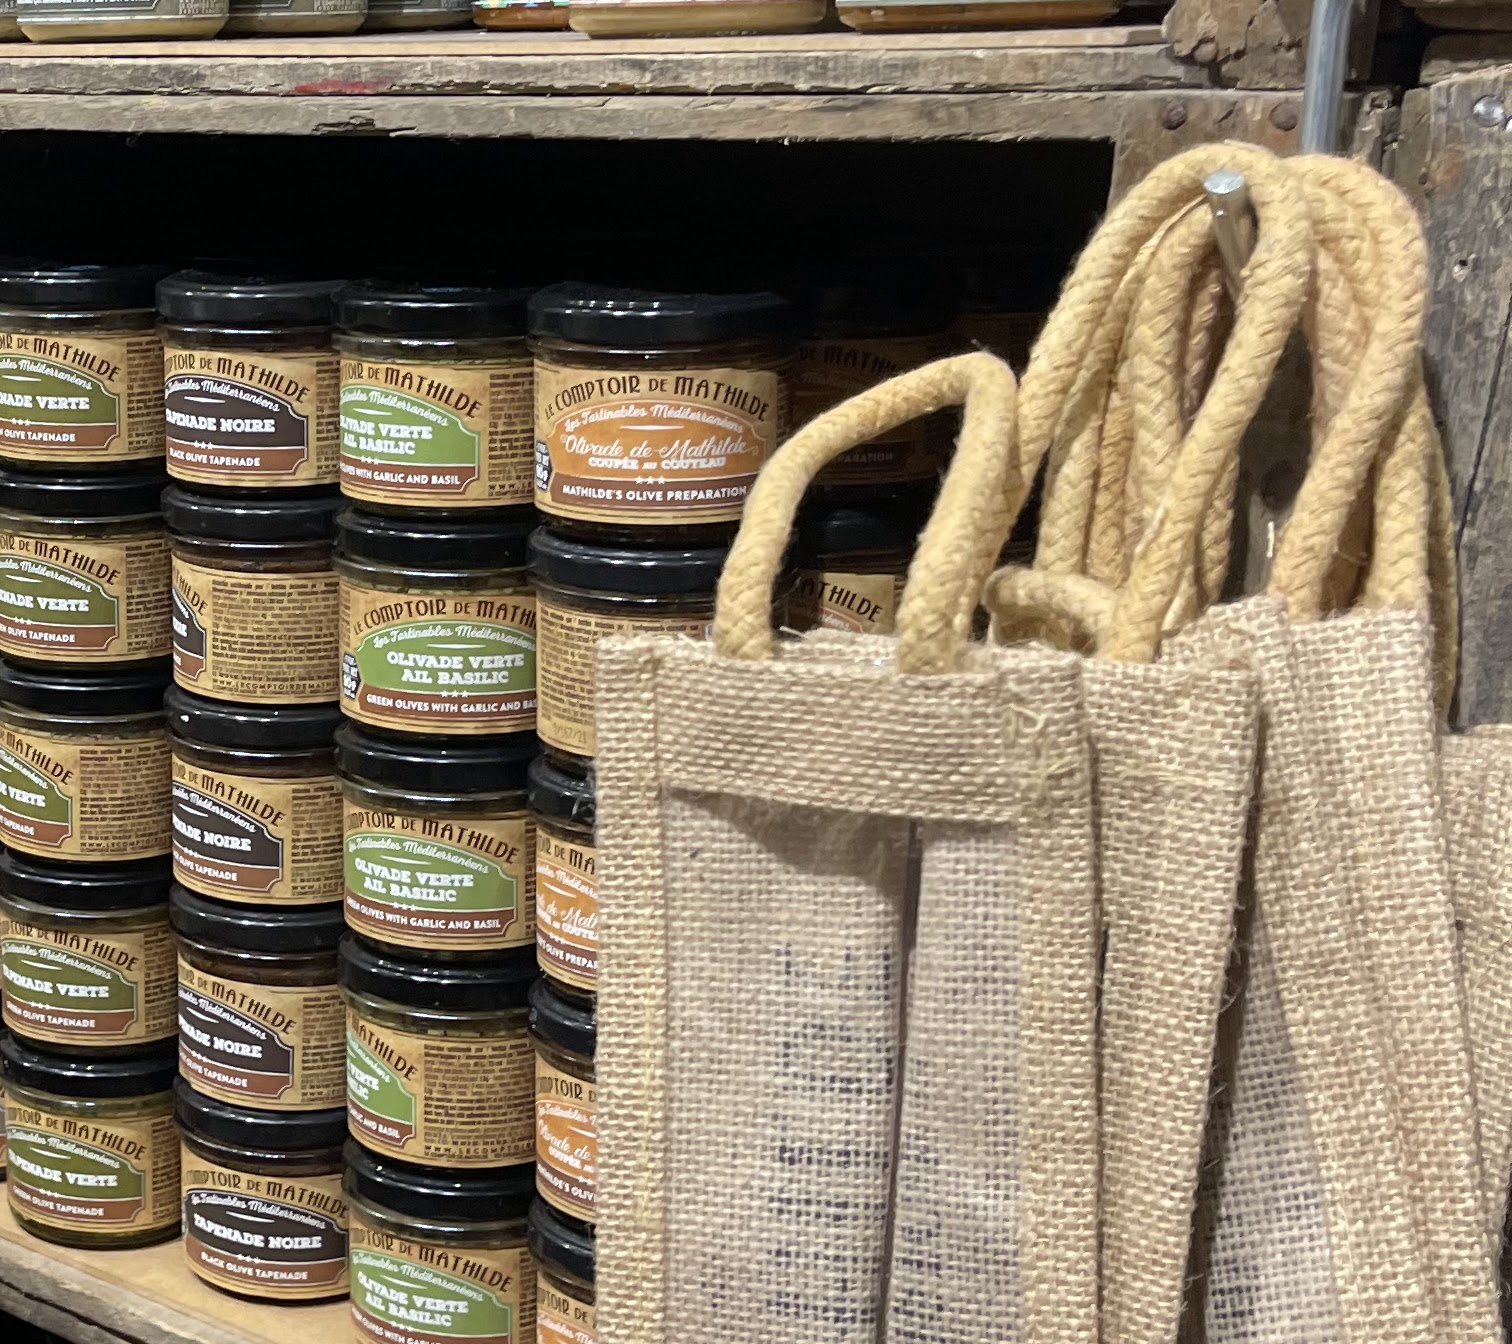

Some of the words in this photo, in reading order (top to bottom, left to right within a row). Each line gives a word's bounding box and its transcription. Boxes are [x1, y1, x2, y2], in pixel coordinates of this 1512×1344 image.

[33, 338, 121, 382] MATHILDE
[217, 357, 310, 404] MATHILDE
[36, 396, 90, 409] VERTE
[554, 375, 640, 413] COMPTOIR
[648, 378, 667, 393] DE
[674, 376, 770, 422] MATHILDE
[220, 418, 275, 432] NOIRE
[4, 430, 26, 440] OLIVE
[27, 432, 75, 442] TAPENADE
[561, 434, 624, 457] Olivade
[630, 440, 652, 458] de
[659, 435, 759, 458] Mathilde
[186, 453, 207, 463] OLIVE
[209, 456, 260, 466] TAPENADE
[661, 457, 726, 470] COUTEAU
[563, 485, 623, 500] MATHILDE'S
[626, 490, 663, 501] OLIVE
[667, 486, 746, 501] PREPARATION
[387, 651, 463, 669] OLIVADE
[468, 653, 525, 668] VERTE
[401, 669, 432, 683] AIL
[437, 671, 509, 684] BASILIC
[366, 694, 393, 706] GREEN
[395, 700, 429, 711] OLIVES
[432, 703, 457, 713] WITH
[461, 701, 498, 713] GARLIC
[500, 699, 520, 711] AND
[422, 819, 520, 864] MATHILDE
[410, 917, 446, 928] GARLIC
[474, 919, 501, 929] BASIL
[266, 1181, 350, 1219] MATHILDE
[193, 1213, 264, 1247] TAPENADE
[268, 1236, 322, 1249] NOIRE
[201, 1252, 224, 1268] BLACK
[226, 1262, 253, 1276] OLIVE
[256, 1269, 308, 1280] TAPENADE
